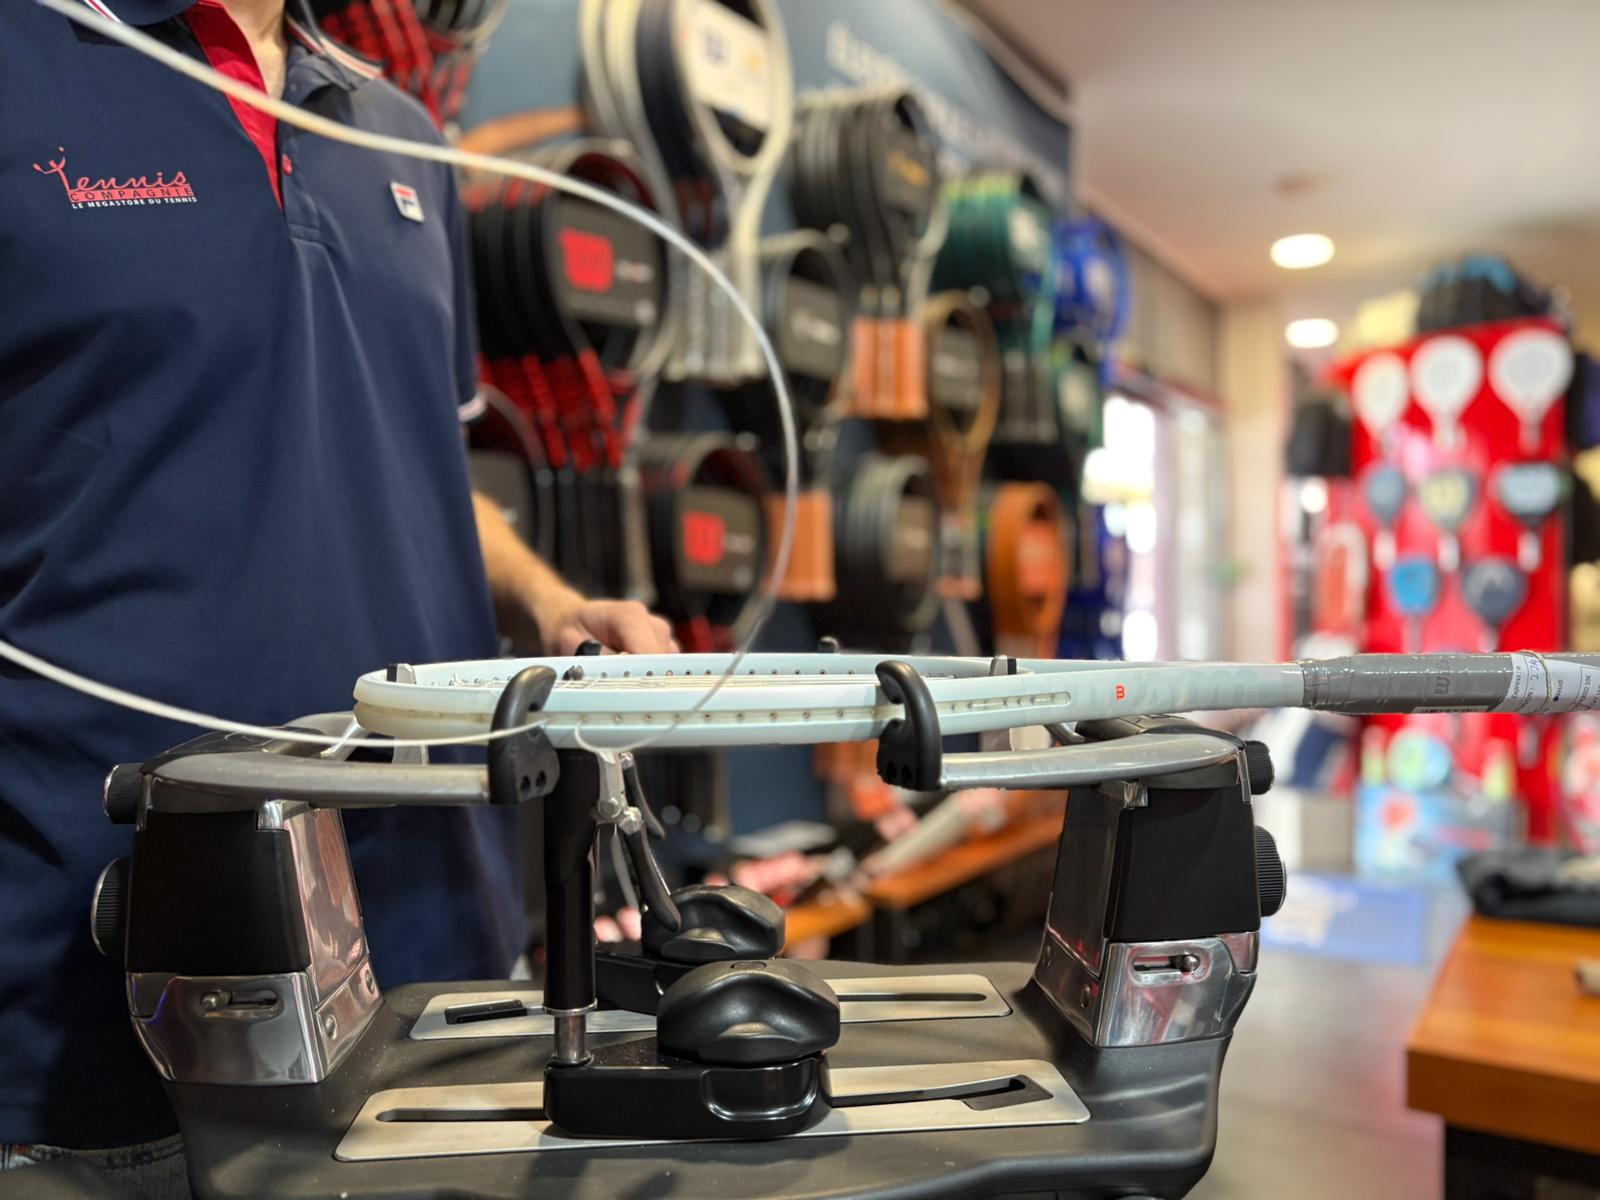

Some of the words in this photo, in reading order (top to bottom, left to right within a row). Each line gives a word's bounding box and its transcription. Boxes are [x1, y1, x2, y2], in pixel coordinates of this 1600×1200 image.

[33, 147, 187, 192] Tennis
[69, 186, 193, 202] COMPAGNIE
[87, 198, 146, 208] MEGASTORE
[165, 196, 198, 204] TENNIS
